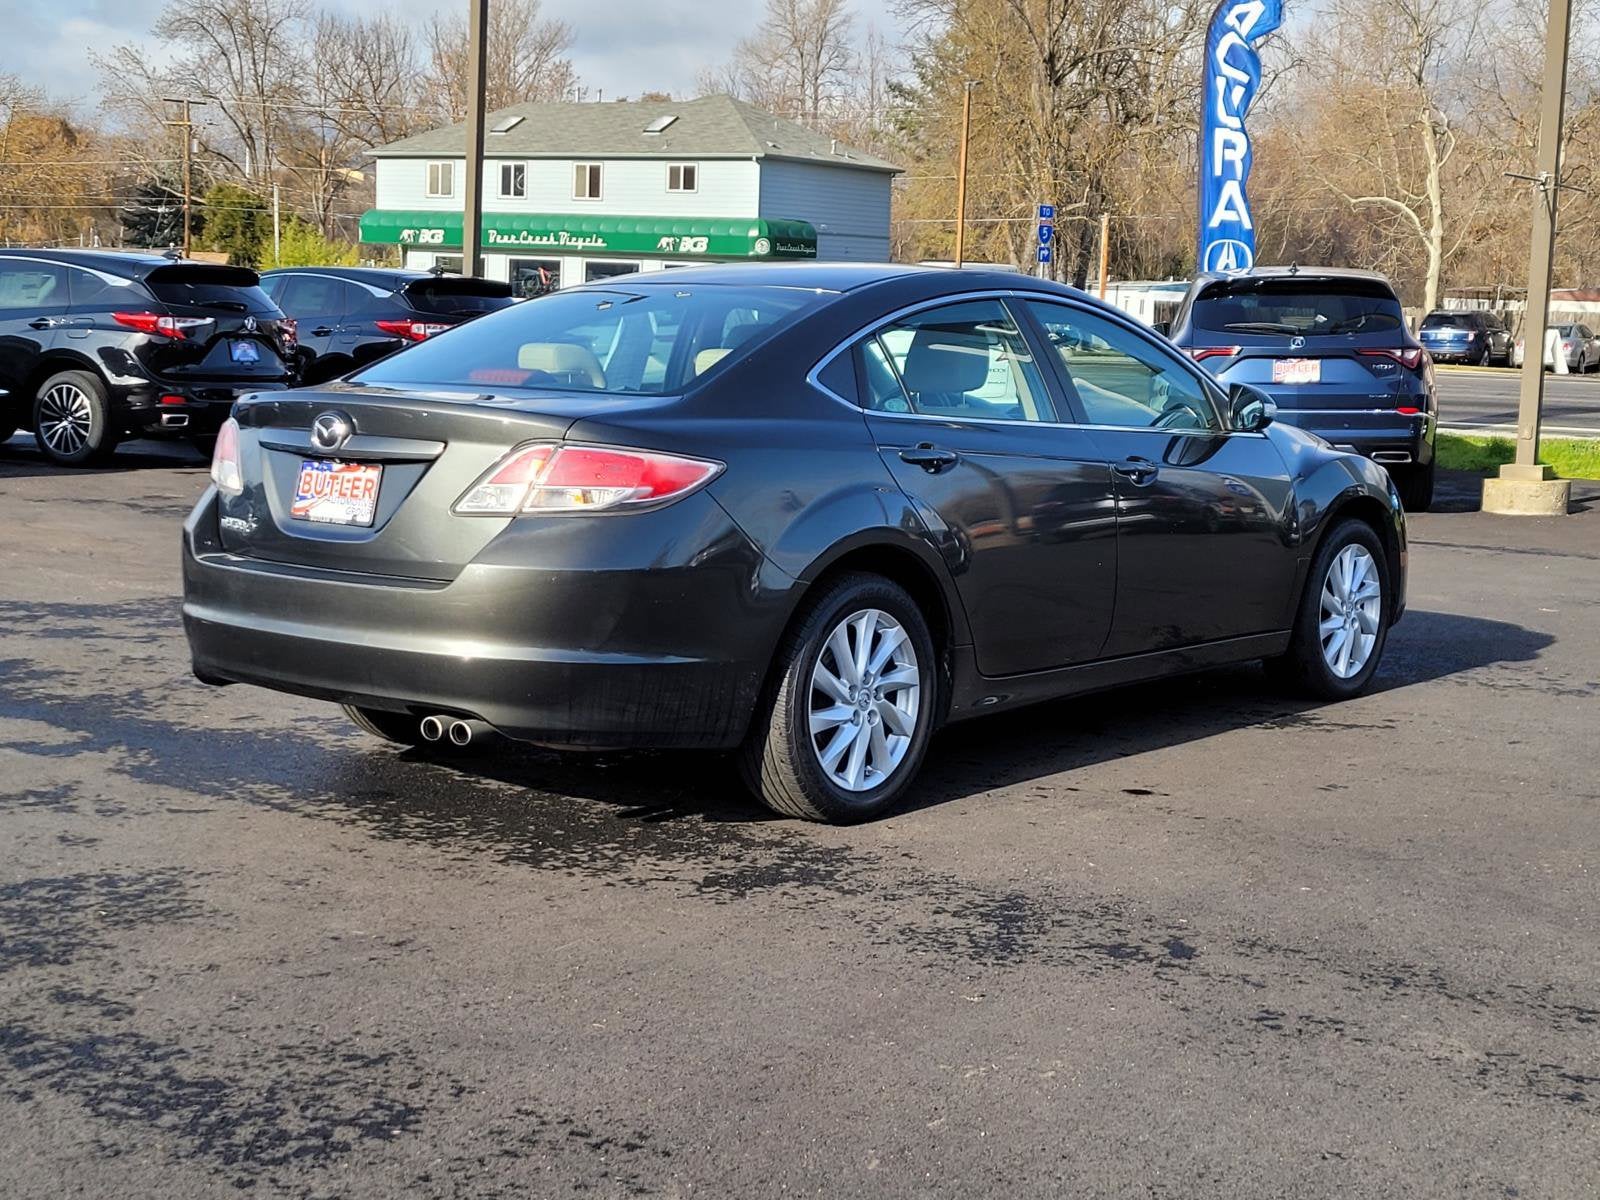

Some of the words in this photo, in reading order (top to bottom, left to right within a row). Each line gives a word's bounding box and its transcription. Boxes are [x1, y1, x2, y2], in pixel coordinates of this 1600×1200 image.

[1209, 0, 1266, 230] ACURA
[1042, 207, 1051, 216] TO
[488, 229, 521, 244] Bear
[519, 230, 559, 246] Creek
[558, 231, 608, 250] Bicycle
[1042, 227, 1049, 239] 5
[1276, 363, 1318, 373] BUTLER
[301, 472, 375, 499] BUTLER
